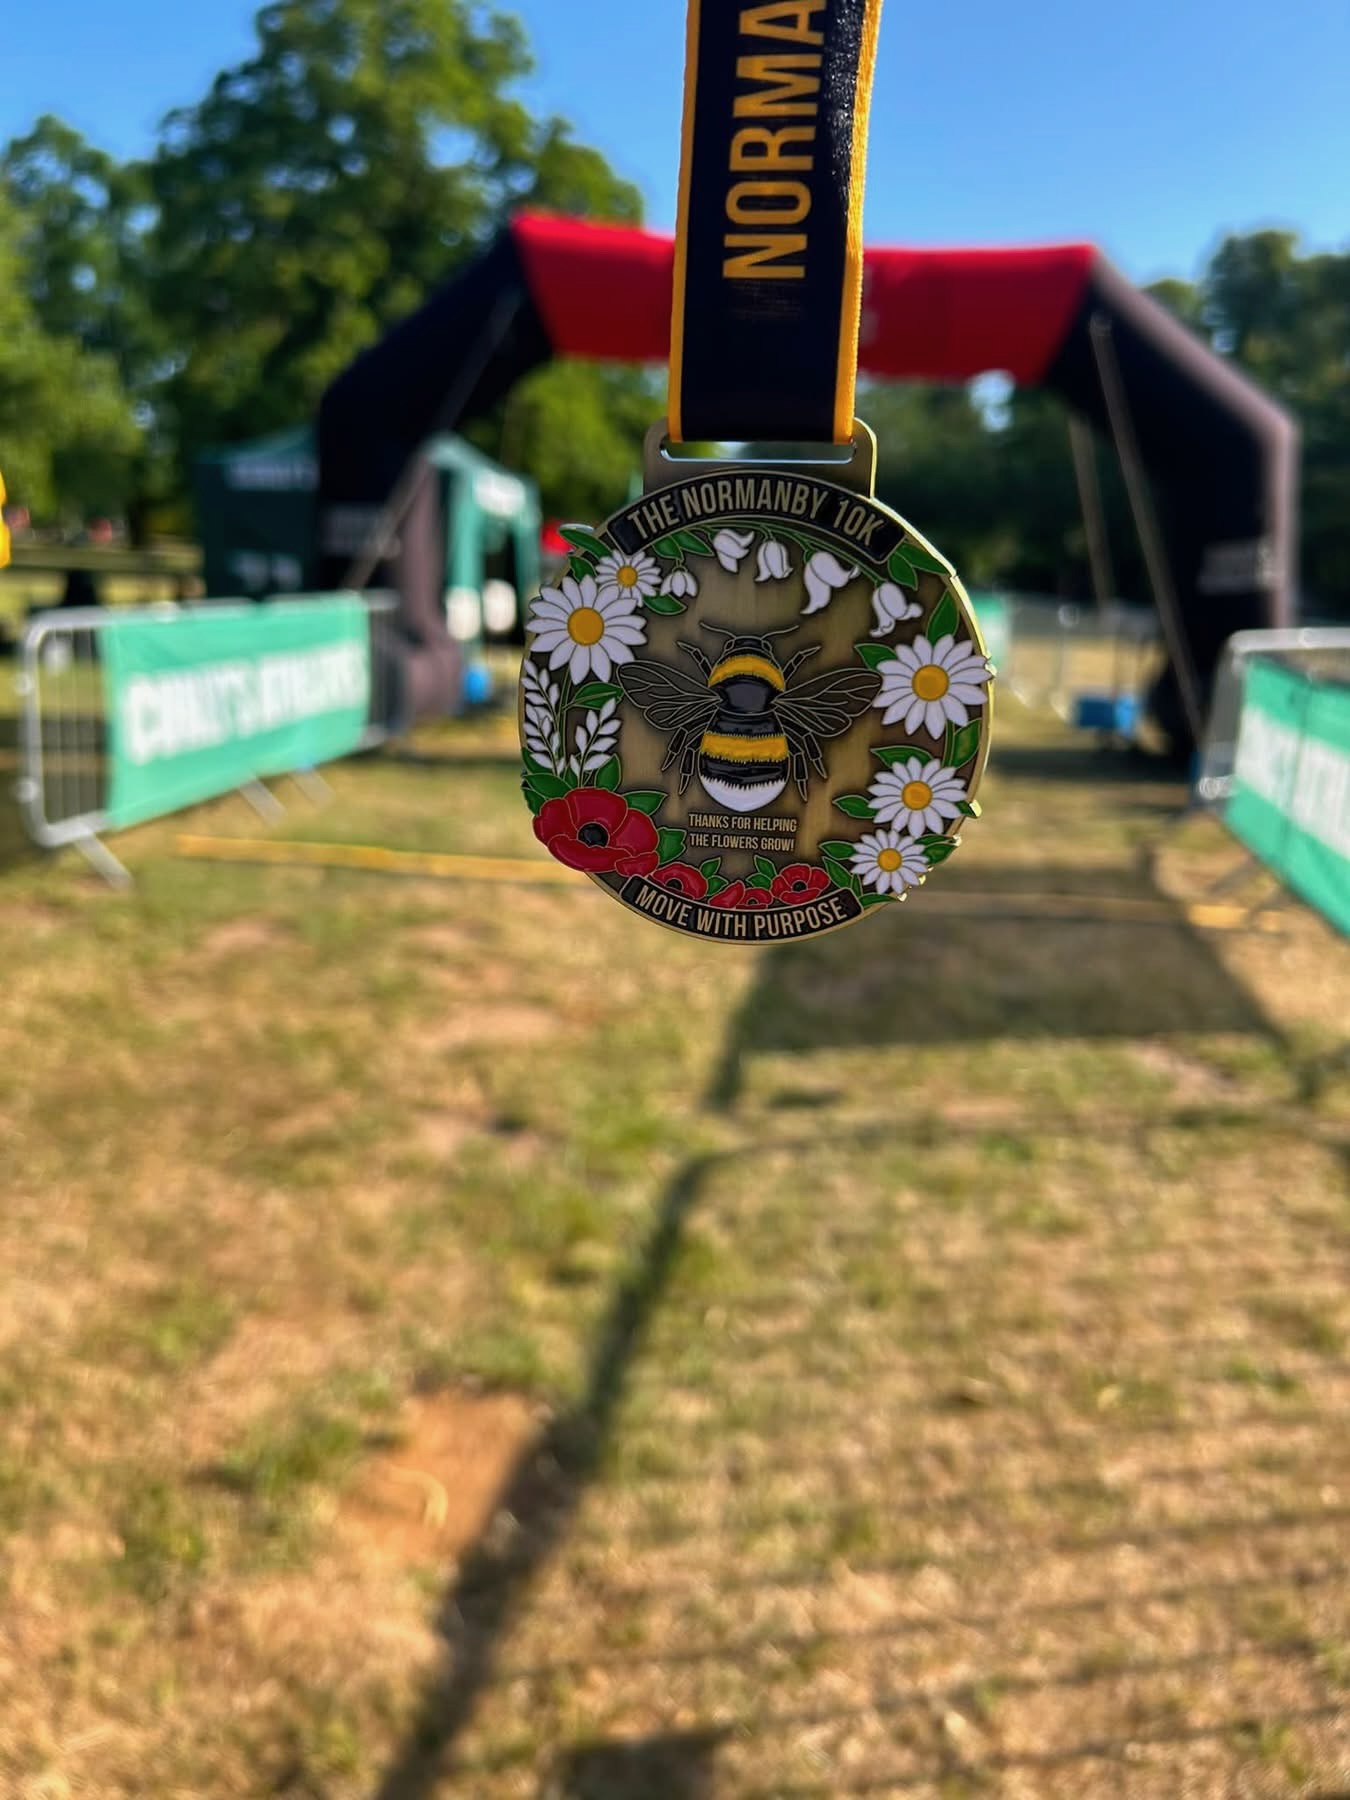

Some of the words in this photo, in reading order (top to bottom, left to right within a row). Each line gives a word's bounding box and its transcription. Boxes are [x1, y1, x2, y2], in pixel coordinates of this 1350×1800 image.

[722, 0, 827, 279] NORMA
[627, 495, 680, 541] THE
[682, 478, 828, 520] NORMANBY
[832, 499, 885, 546] 10K
[689, 813, 729, 829] THANKS
[731, 816, 751, 830] FOR
[754, 817, 797, 833] HELPING
[690, 833, 709, 848] THE
[711, 835, 758, 850] FLOWERS
[761, 838, 795, 851] GROW!
[634, 884, 692, 927] MOVE
[697, 908, 747, 937] WITH
[754, 896, 847, 937] PURPOSE
